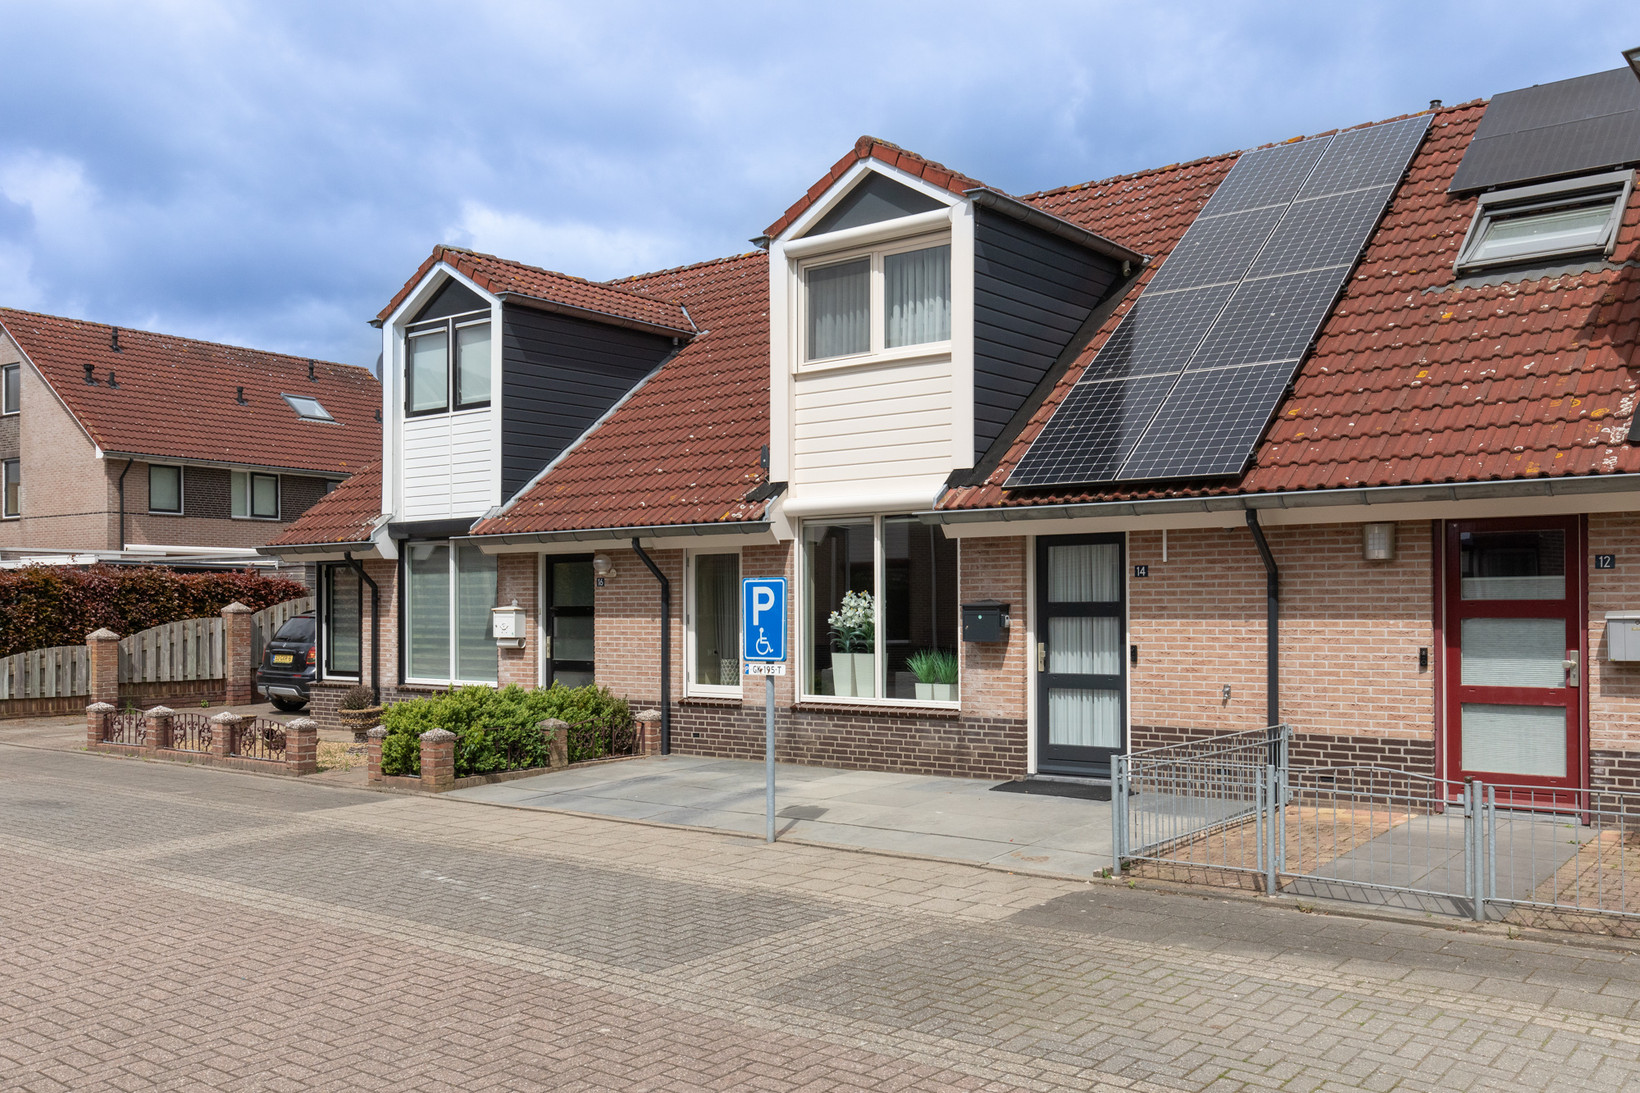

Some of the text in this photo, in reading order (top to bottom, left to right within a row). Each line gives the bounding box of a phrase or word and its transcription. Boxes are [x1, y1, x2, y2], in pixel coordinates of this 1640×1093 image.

[1599, 555, 1611, 568] 12
[1136, 566, 1146, 577] 14
[753, 586, 775, 626] P
